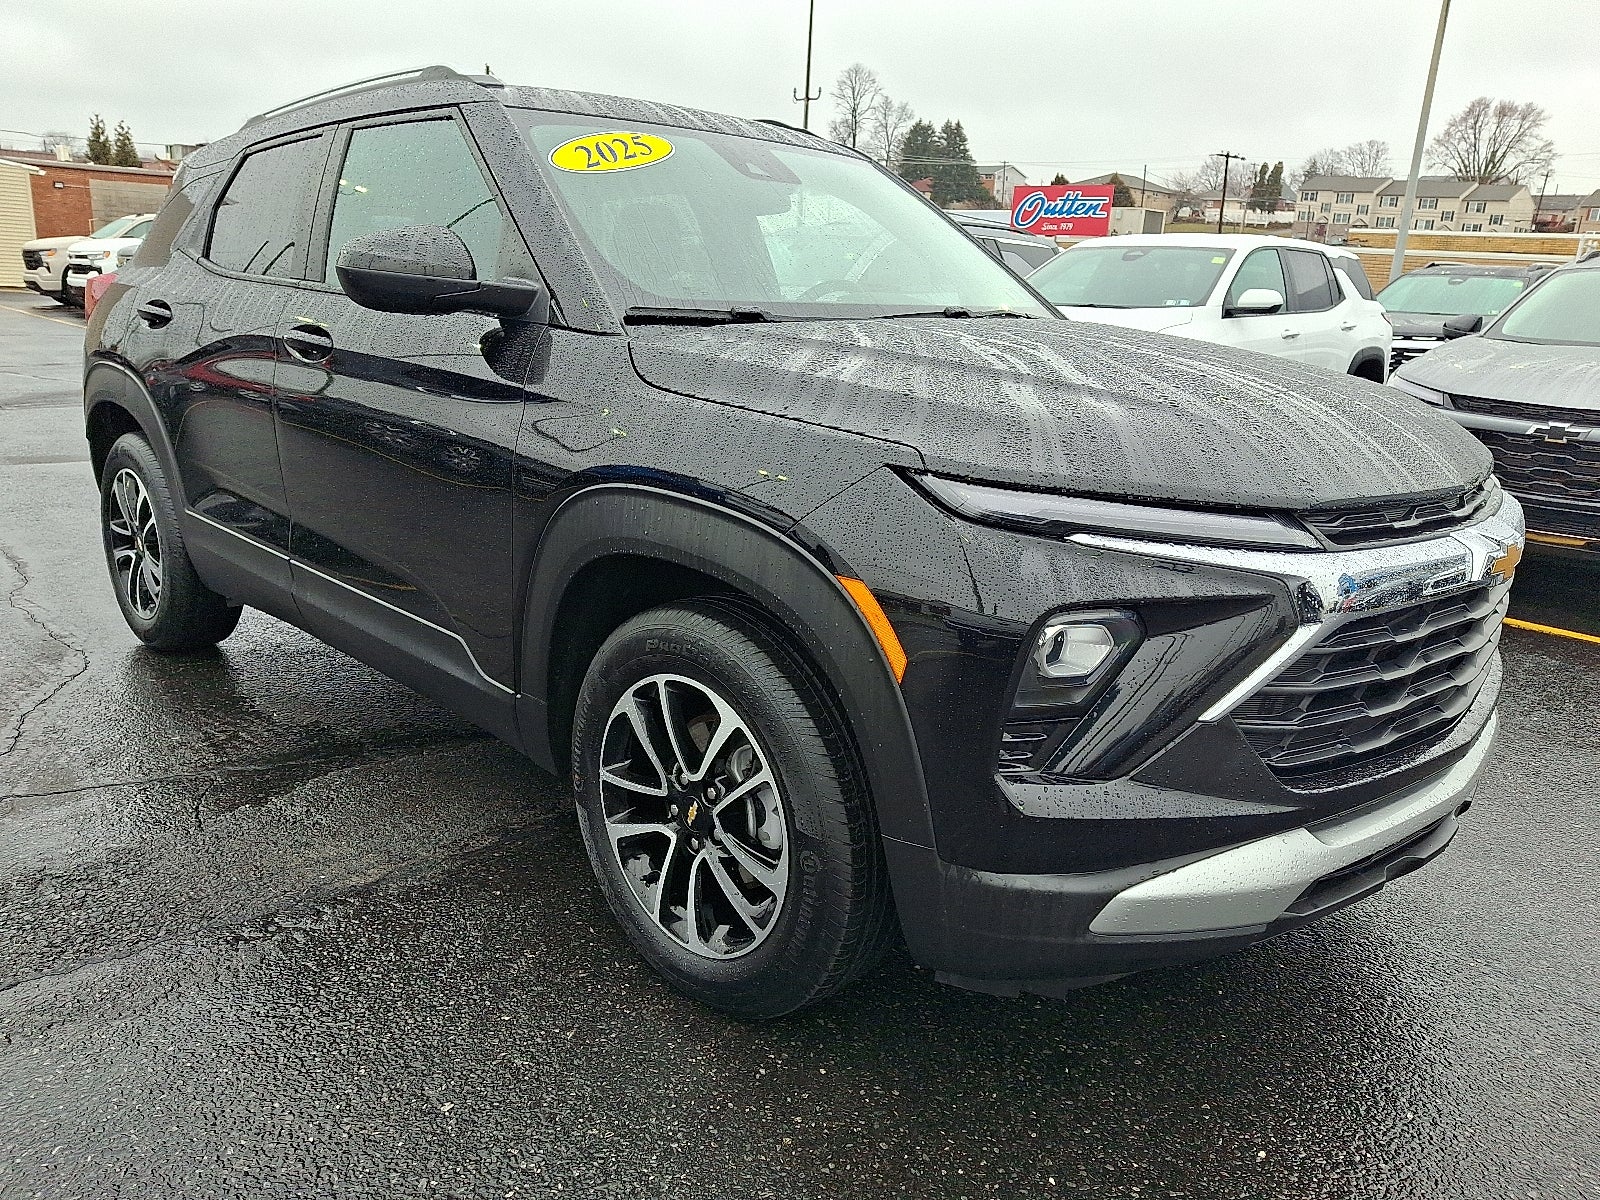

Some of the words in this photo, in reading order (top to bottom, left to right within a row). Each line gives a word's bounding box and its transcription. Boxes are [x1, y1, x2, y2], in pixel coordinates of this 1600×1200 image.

[574, 135, 652, 168] 2025
[1013, 191, 1109, 229] Outten
[1041, 222, 1058, 231] Since
[1059, 222, 1073, 231] 1979
